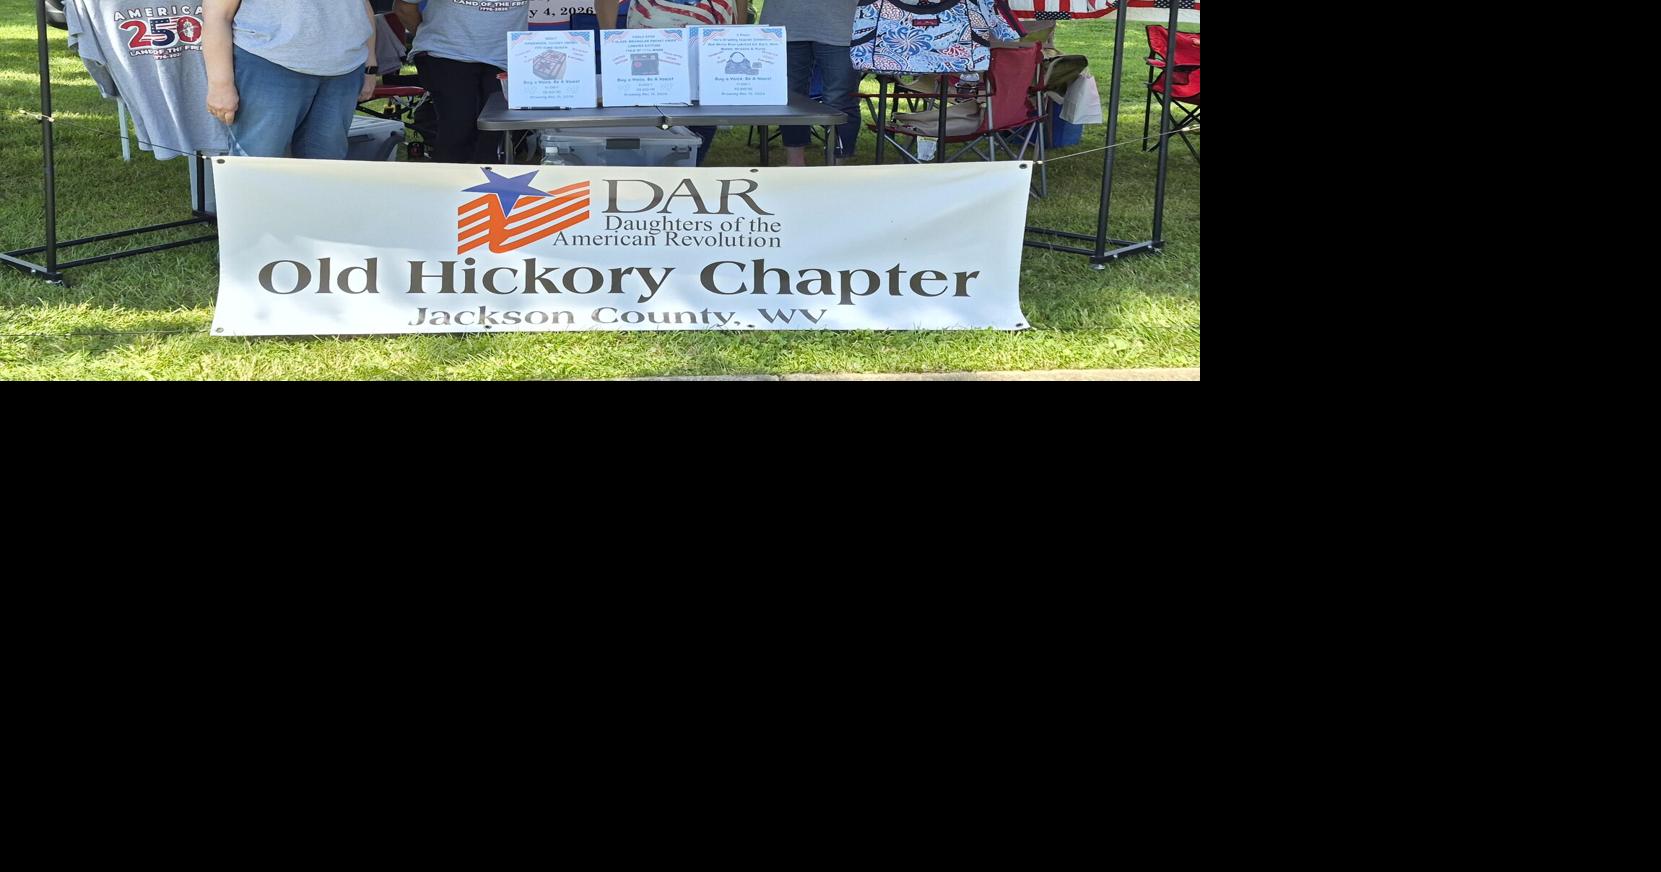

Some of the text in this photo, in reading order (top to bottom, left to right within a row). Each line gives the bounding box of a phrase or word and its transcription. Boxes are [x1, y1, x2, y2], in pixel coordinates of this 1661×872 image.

[113, 6, 203, 21] AMERICA
[543, 7, 556, 17] 4,
[560, 6, 594, 16] 2026
[119, 15, 204, 49] 250
[602, 179, 775, 215] DAR
[605, 216, 781, 235] Daughters of the
[553, 230, 781, 247] American Revolution
[258, 257, 980, 305] Old Hickory Chapter
[408, 305, 828, 327] Jackson County, WV
